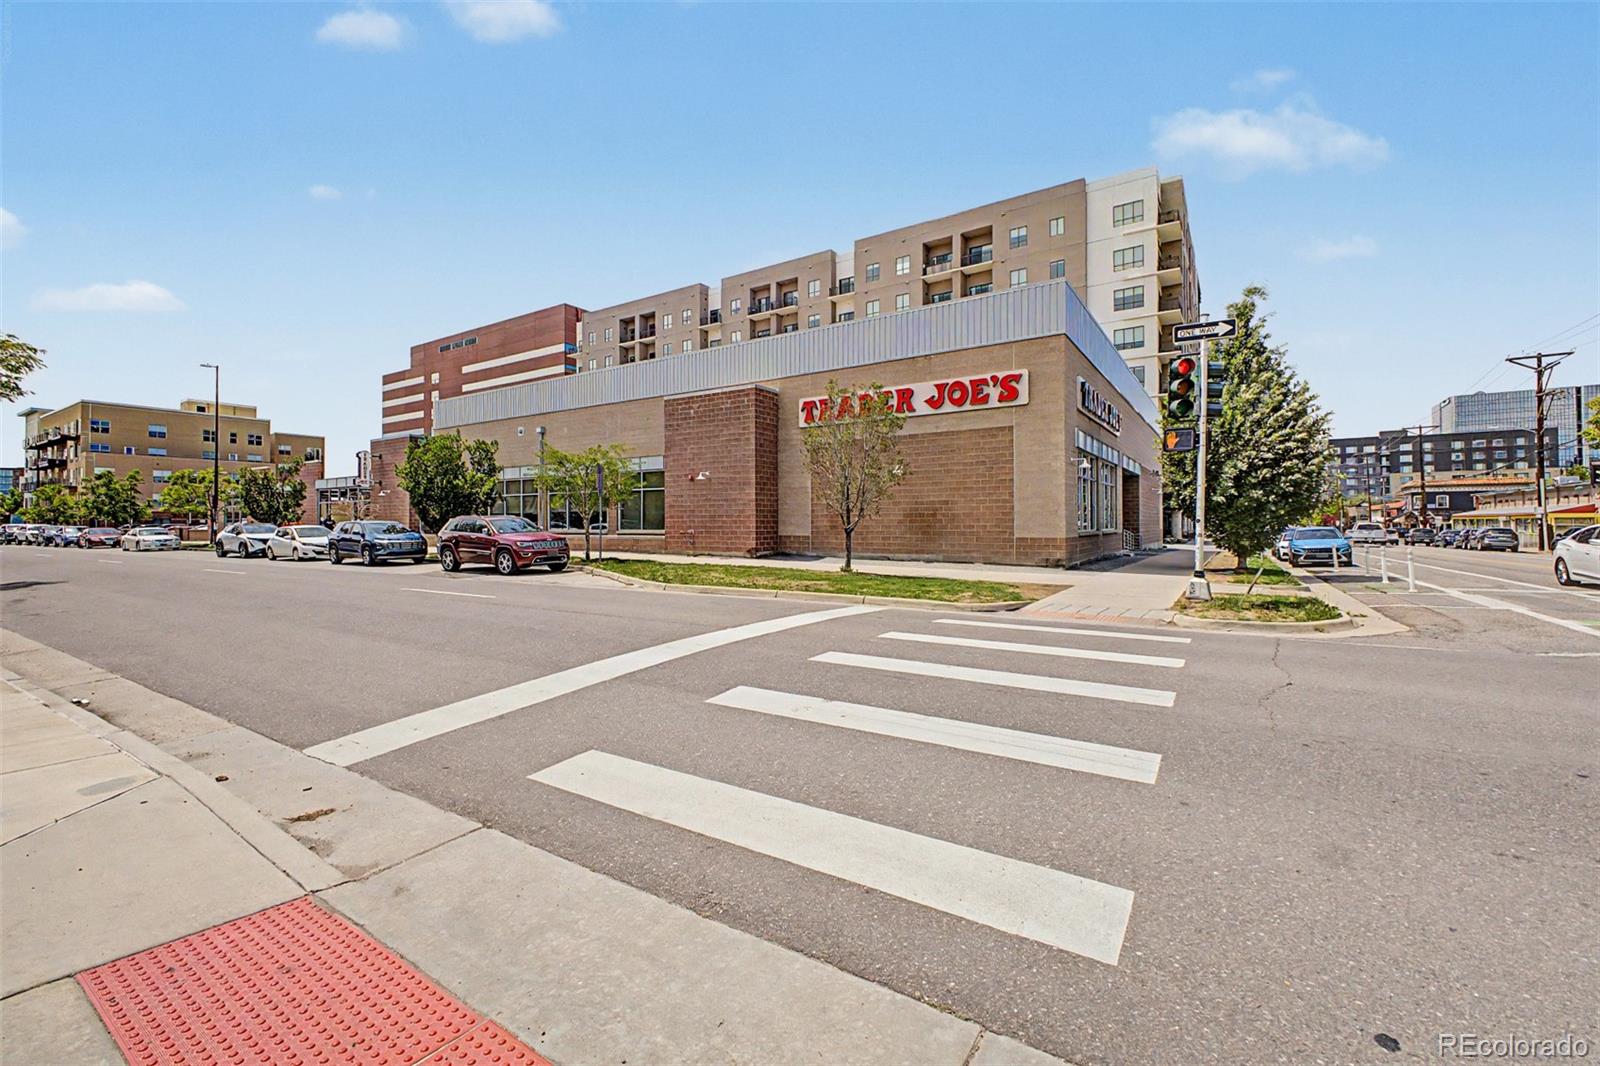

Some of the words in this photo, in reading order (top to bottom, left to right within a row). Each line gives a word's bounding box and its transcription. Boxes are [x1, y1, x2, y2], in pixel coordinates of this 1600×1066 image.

[1180, 328, 1196, 337] ONE
[1199, 326, 1217, 335] WAY
[924, 373, 1023, 410] JOE'S
